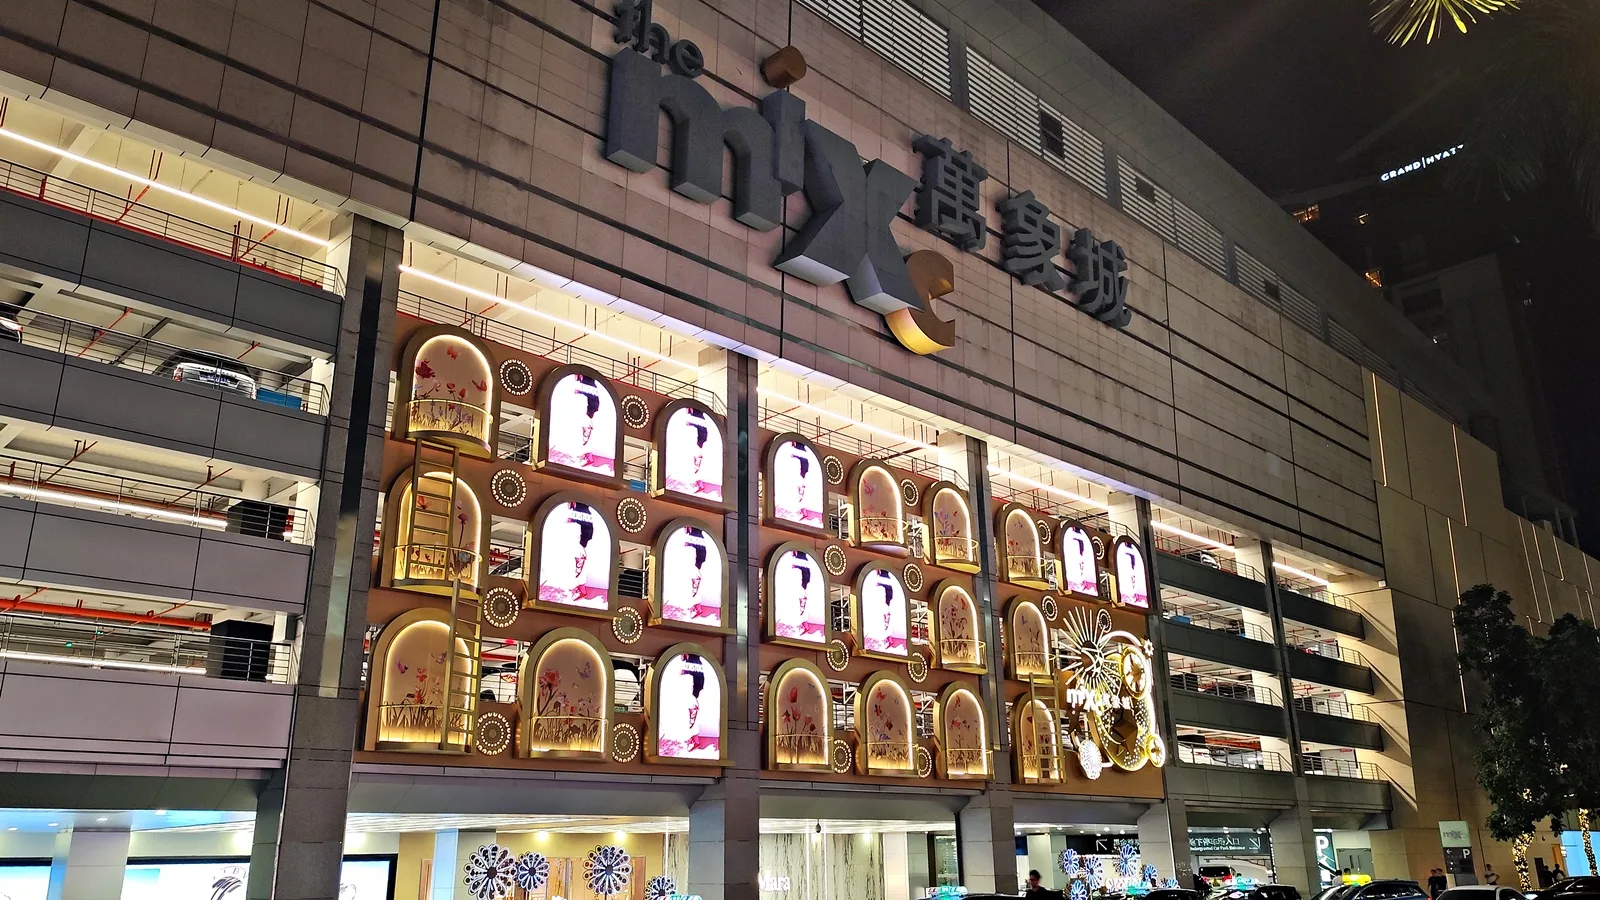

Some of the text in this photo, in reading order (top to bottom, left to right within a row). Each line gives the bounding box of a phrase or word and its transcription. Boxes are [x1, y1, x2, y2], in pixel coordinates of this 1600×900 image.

[614, 0, 705, 79] the
[1380, 161, 1422, 182] GRAND
[912, 133, 1133, 329] 萬象城
[1315, 835, 1330, 856] P
[1462, 848, 1471, 859] P
